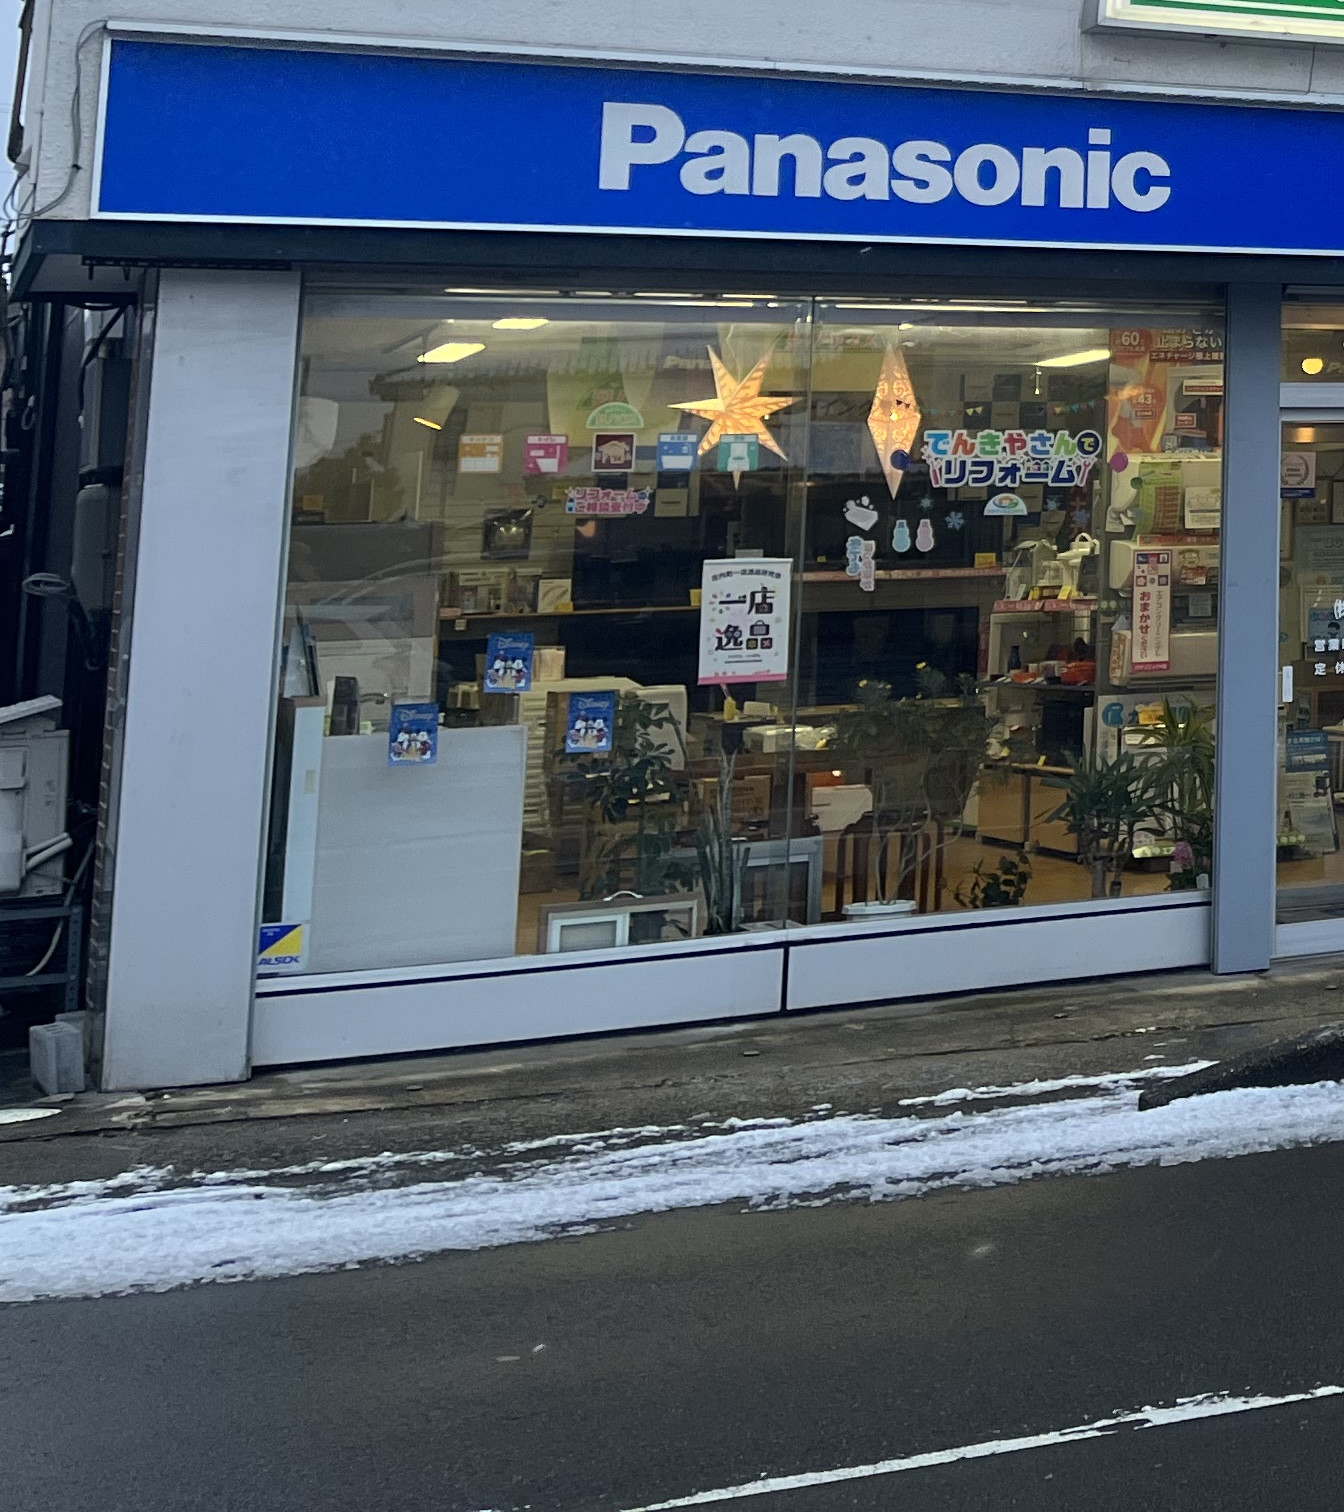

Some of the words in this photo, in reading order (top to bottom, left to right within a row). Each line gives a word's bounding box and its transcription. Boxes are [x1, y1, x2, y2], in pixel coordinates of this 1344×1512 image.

[599, 101, 1171, 213] Panasonic
[1121, 332, 1139, 345] 60
[1156, 336, 1222, 348] 止まらない
[925, 430, 1100, 457] でんきやさんで
[943, 458, 1077, 486] リフォーム
